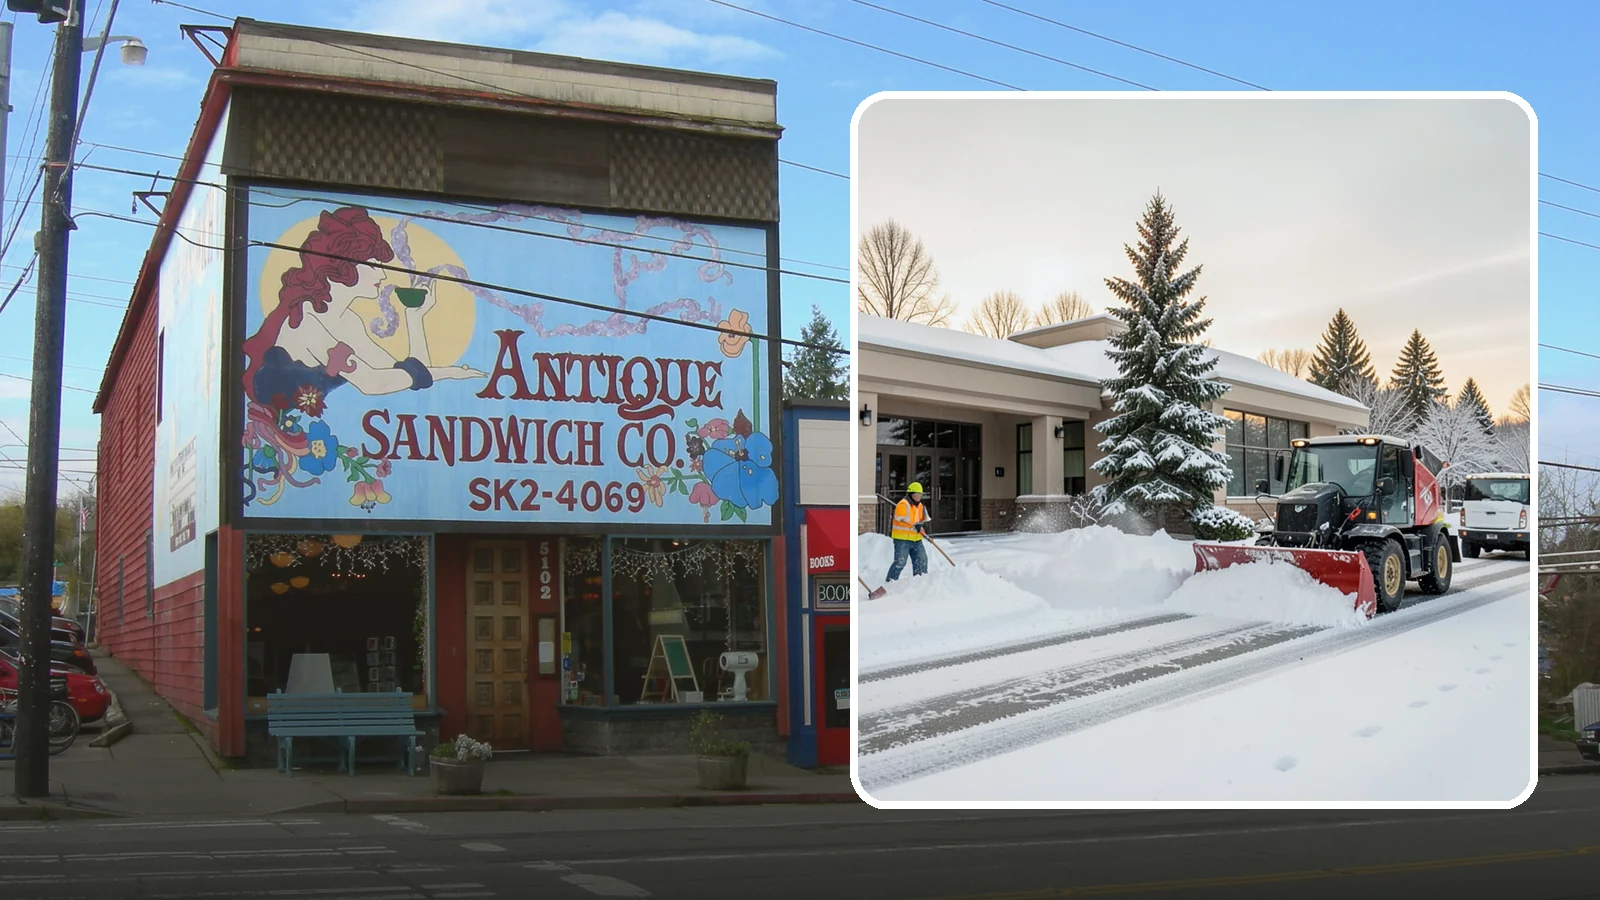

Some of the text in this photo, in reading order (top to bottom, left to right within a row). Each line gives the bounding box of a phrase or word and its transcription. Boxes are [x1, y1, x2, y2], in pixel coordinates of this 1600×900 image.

[475, 329, 723, 421] ANTIQUE
[361, 409, 685, 469] SANDWICH CO.
[469, 477, 645, 513] SK2-4069
[539, 541, 551, 600] 5102
[809, 555, 835, 569] BOOKS
